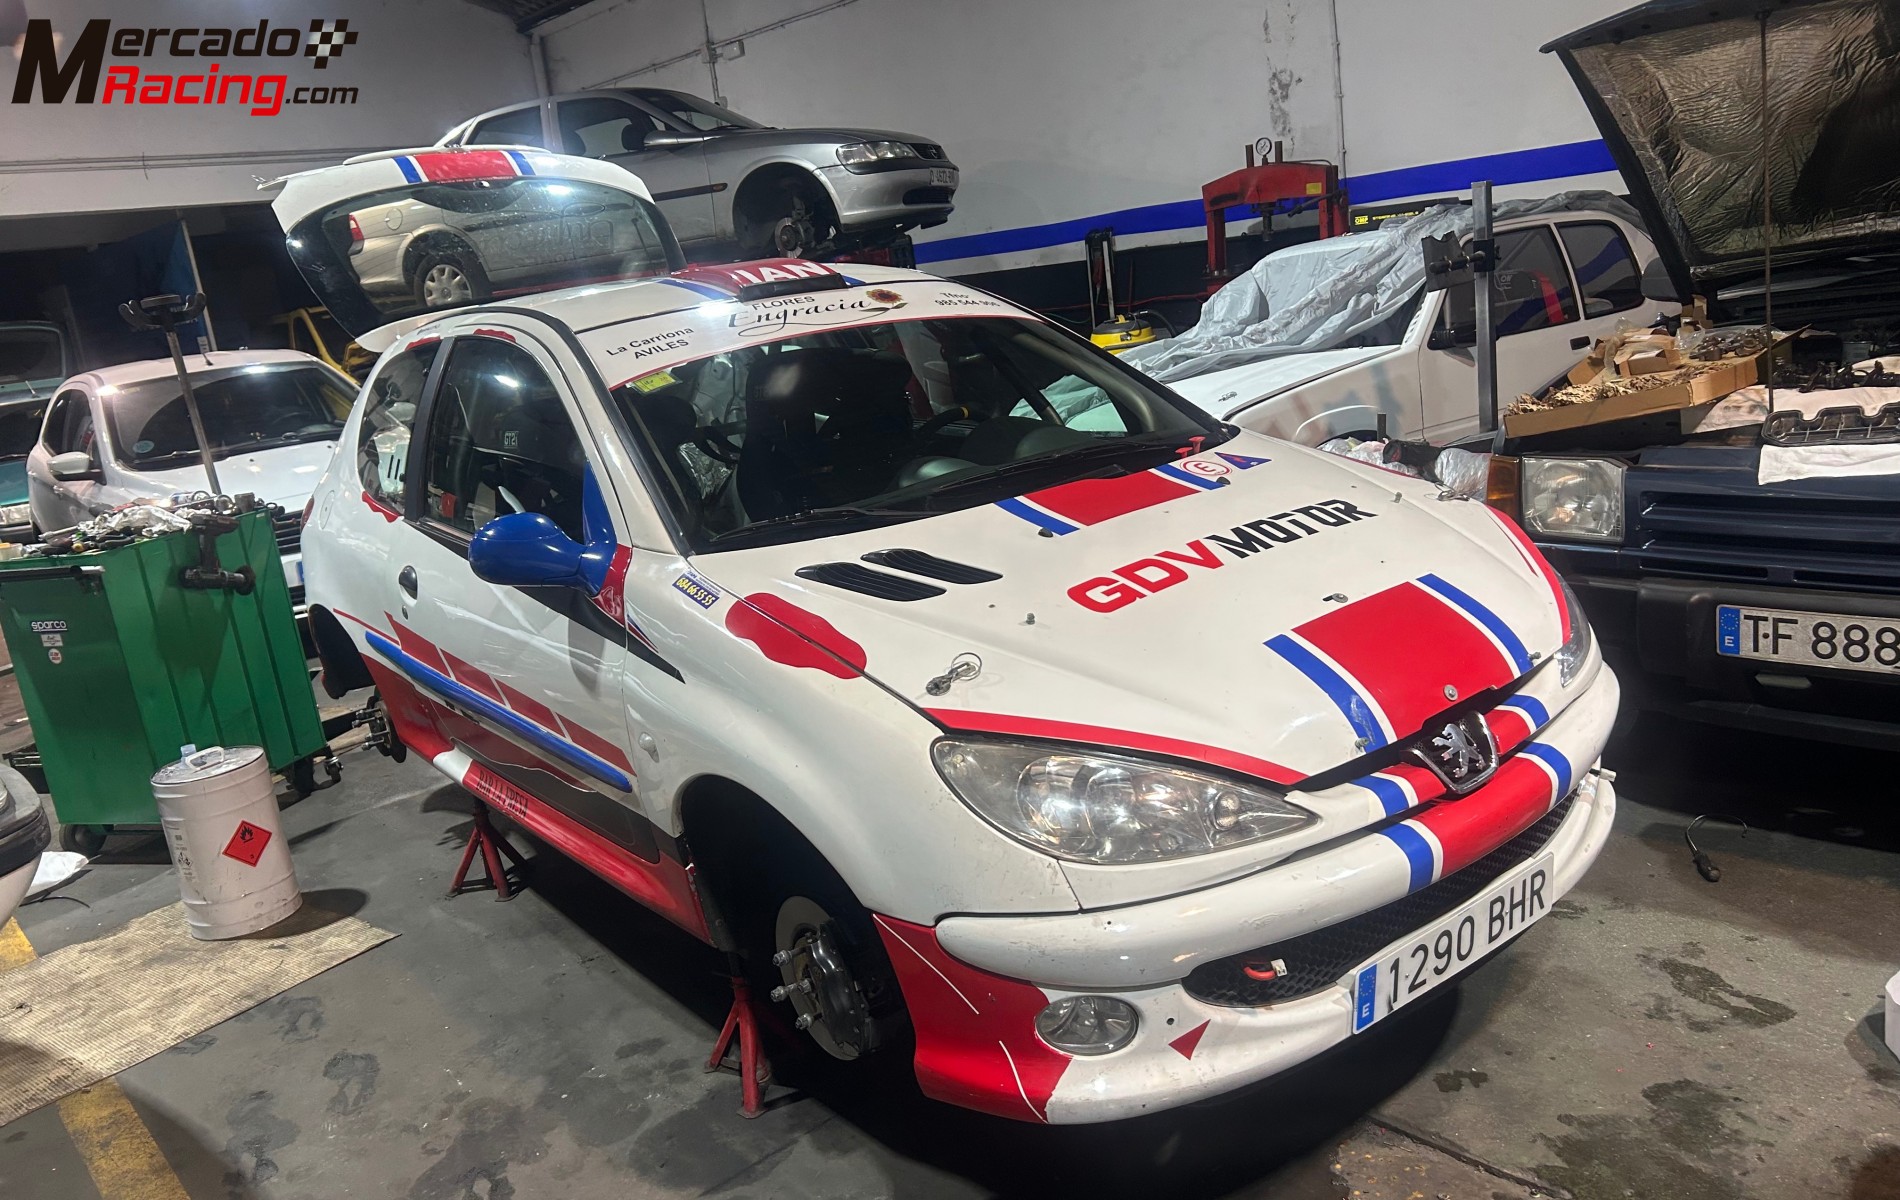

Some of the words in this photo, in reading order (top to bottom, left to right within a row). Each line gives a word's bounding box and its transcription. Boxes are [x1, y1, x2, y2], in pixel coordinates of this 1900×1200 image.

[752, 296, 815, 310] FLORES
[728, 298, 873, 336] Engracia
[606, 346, 627, 356] La
[629, 328, 694, 348] Carriona
[634, 339, 689, 359] AVILES
[31, 621, 67, 631] sparco
[1725, 636, 1734, 647] E
[1389, 915, 1475, 1004] 1290
[1487, 869, 1546, 945] BHR
[1361, 1002, 1370, 1018] E
